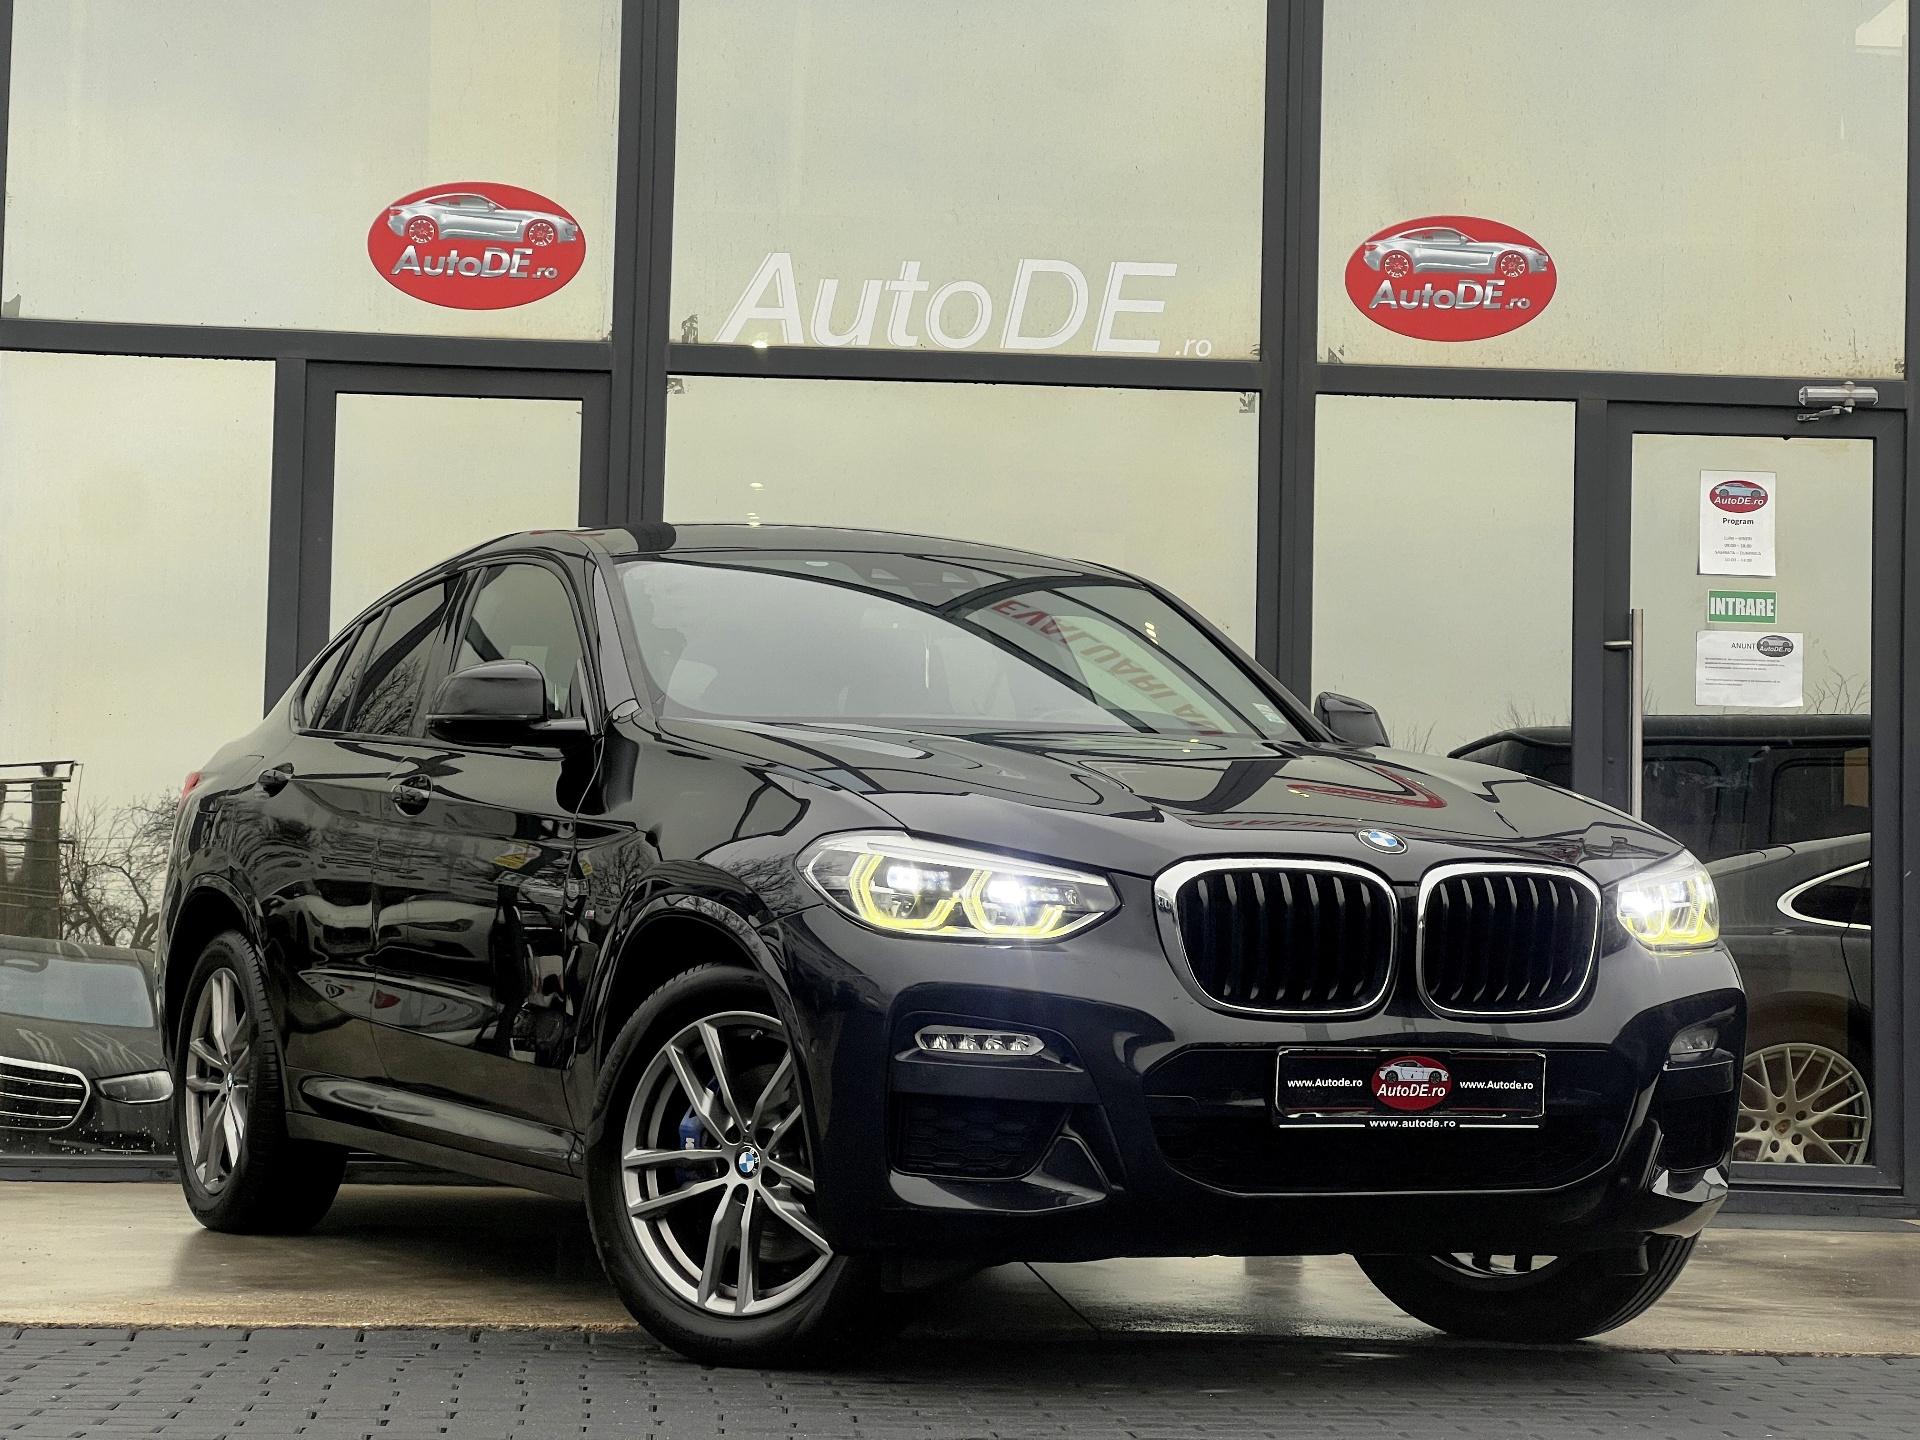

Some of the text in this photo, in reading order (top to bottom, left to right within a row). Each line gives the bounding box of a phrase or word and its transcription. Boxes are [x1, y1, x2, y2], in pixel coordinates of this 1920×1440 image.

[1713, 496, 1764, 506] AutoDE.ro
[1722, 517, 1754, 526] Program
[1710, 597, 1775, 617] INTRARE
[1759, 645, 1792, 653] AutoDE.ro
[1287, 1078, 1363, 1088] www.Autode.ro
[1459, 1080, 1534, 1090] www.Autode.ro
[1376, 1083, 1446, 1098] AutoDE.ro
[1369, 1118, 1456, 1129] www.autode.ro
